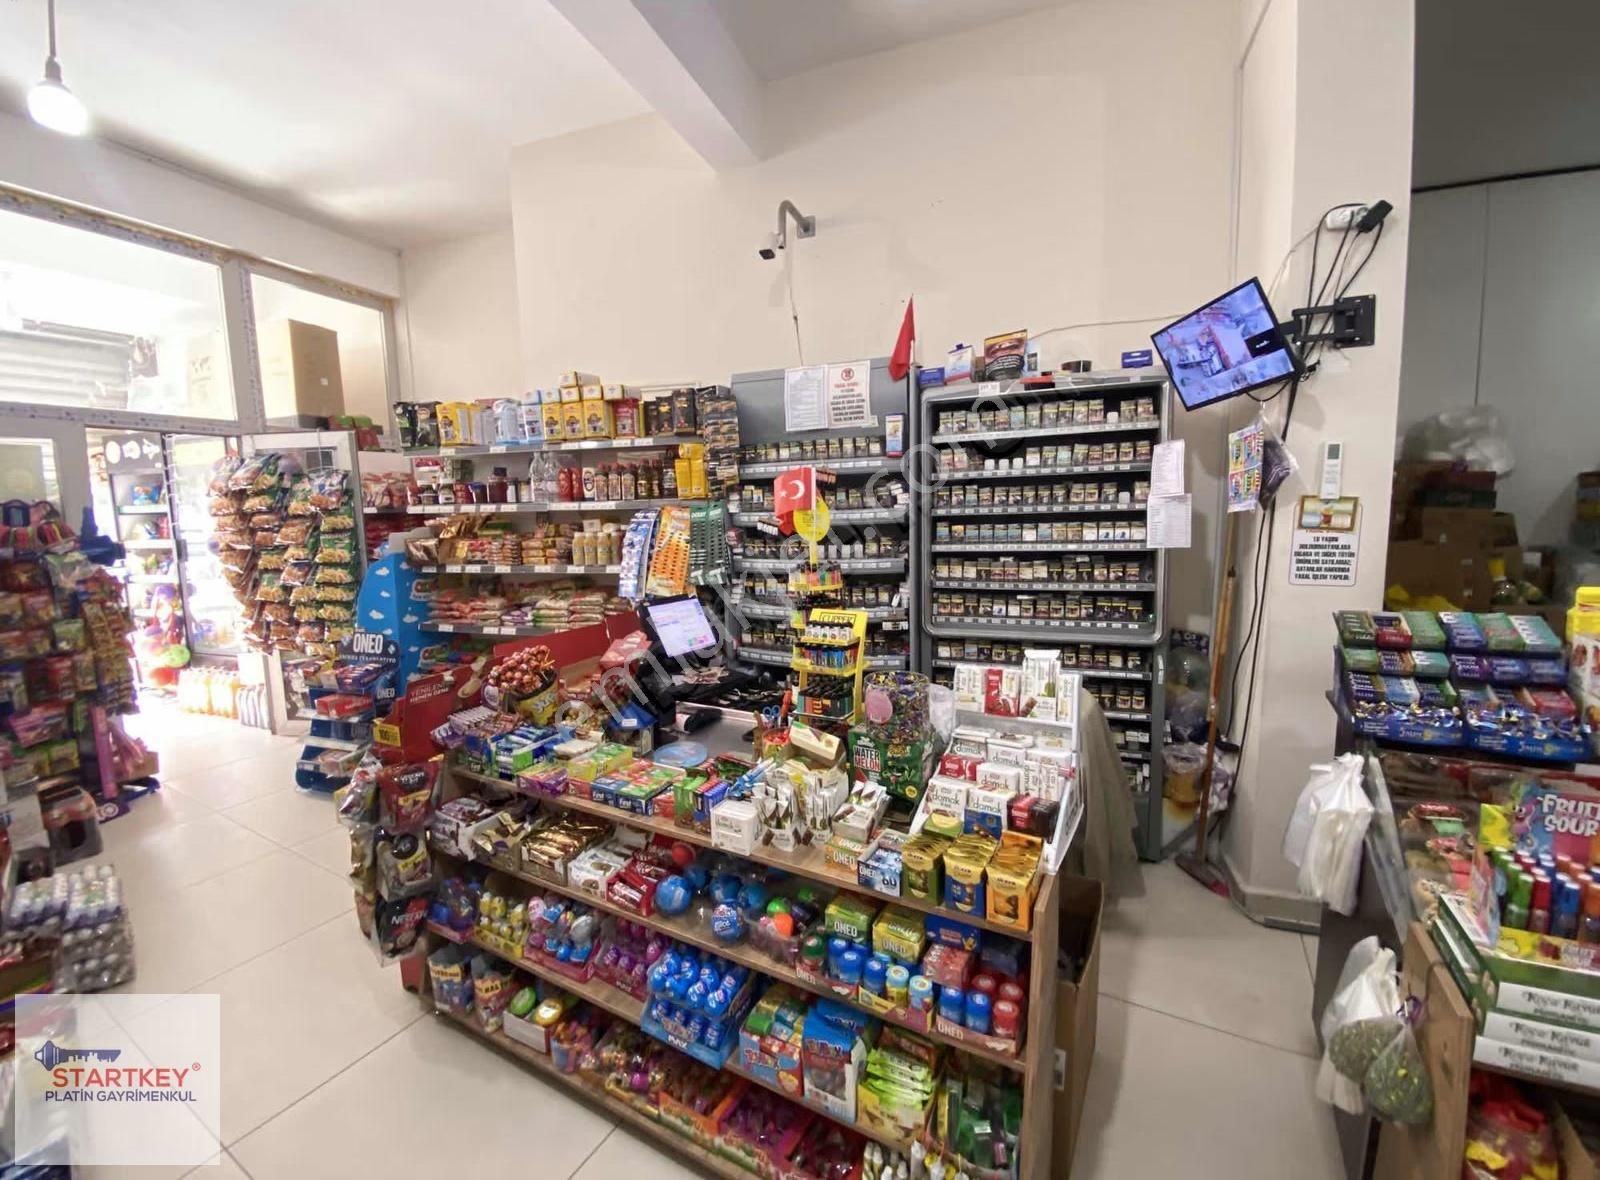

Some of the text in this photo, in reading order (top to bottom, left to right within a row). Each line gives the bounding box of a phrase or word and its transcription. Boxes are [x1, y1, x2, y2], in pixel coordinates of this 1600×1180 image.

[353, 633, 383, 654] ONEO
[377, 688, 395, 700] ONEO
[853, 745, 880, 760] WATER
[854, 756, 881, 773] MELON
[1544, 814, 1600, 837] SOUR
[833, 920, 858, 938] ONEO
[937, 1022, 964, 1041] ONEO
